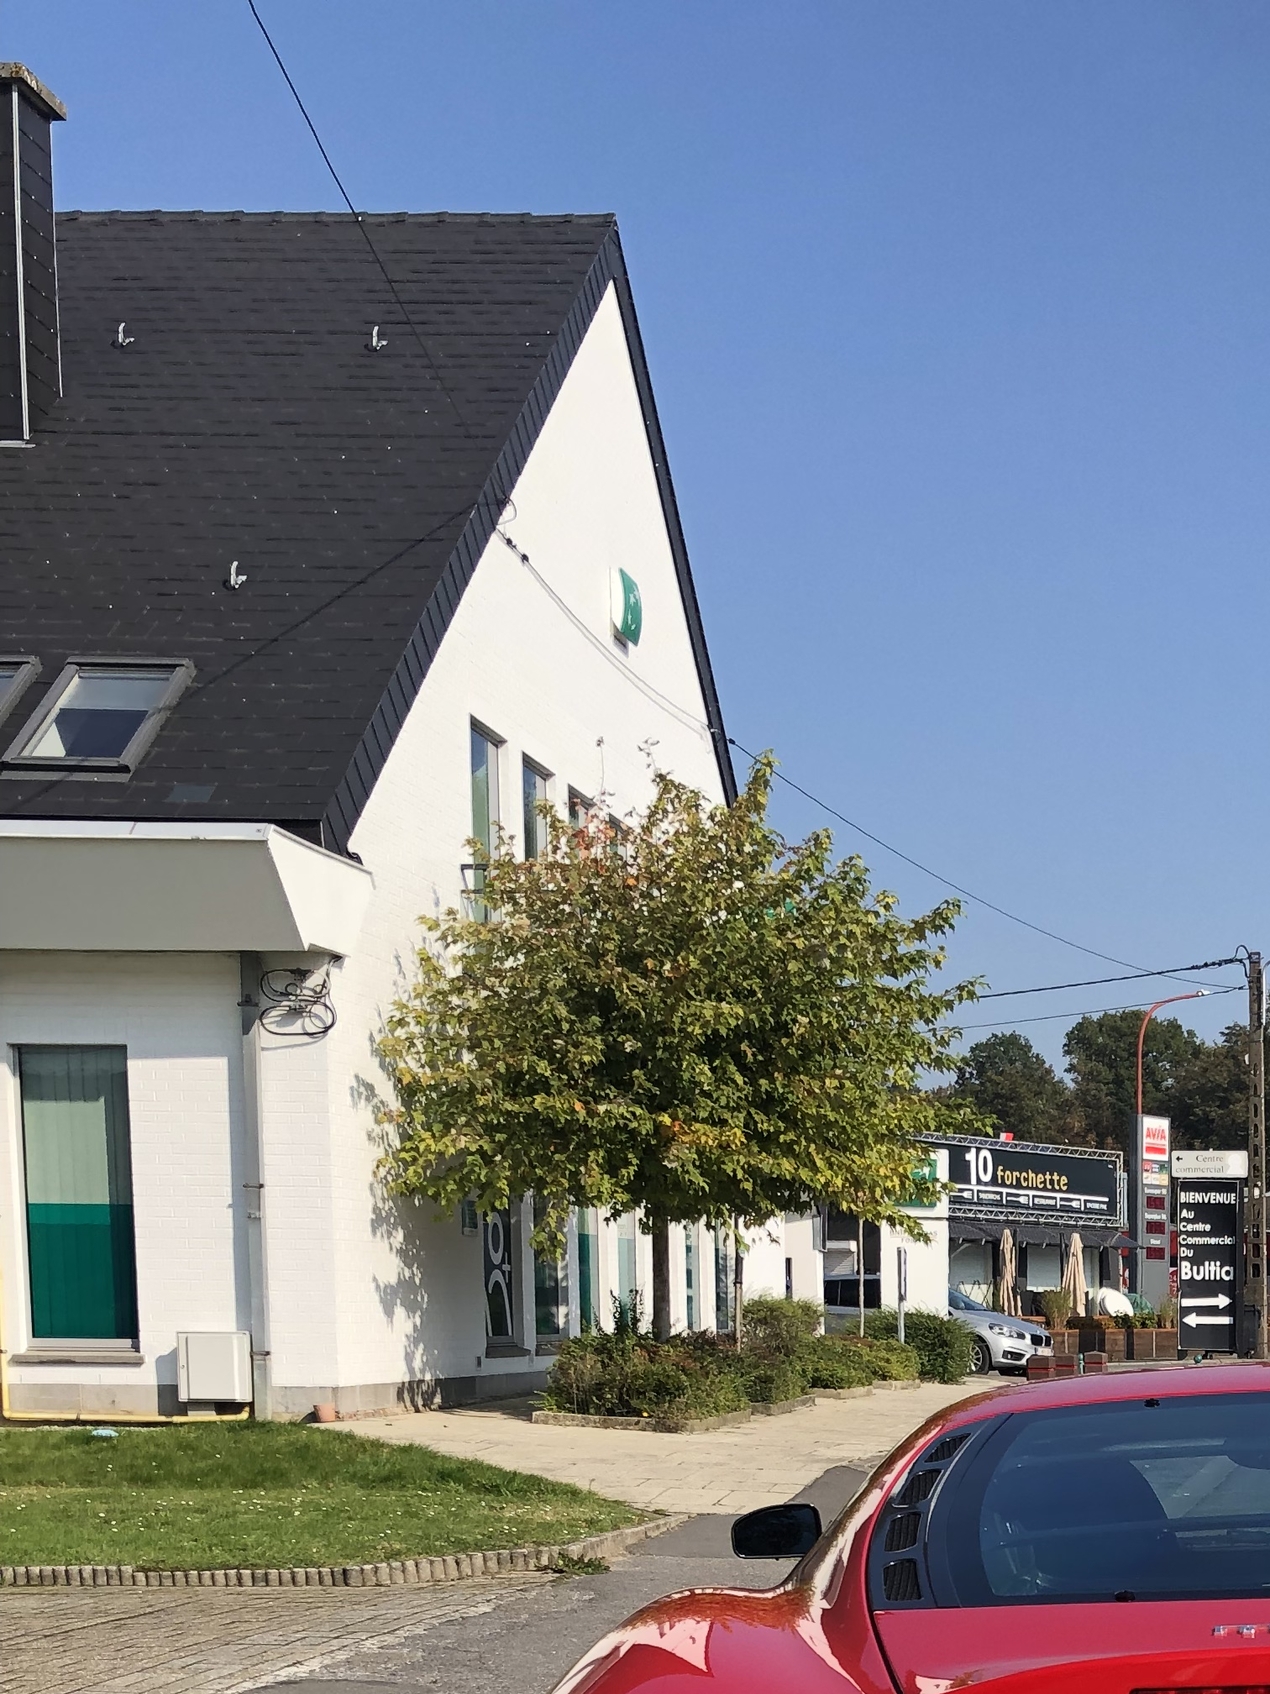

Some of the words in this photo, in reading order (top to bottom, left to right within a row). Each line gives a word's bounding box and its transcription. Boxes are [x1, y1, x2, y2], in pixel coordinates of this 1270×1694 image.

[1195, 1154, 1224, 1163] Centre
[965, 1148, 993, 1186] 10
[997, 1166, 1069, 1191] forchette
[1175, 1165, 1225, 1174] commercial
[1180, 1192, 1236, 1204] BIENVENUE
[1180, 1209, 1195, 1219] Au
[1180, 1222, 1211, 1232] Centre
[1180, 1235, 1236, 1245] Commercial
[1180, 1247, 1194, 1257] Du
[1180, 1260, 1234, 1280] Bultia
